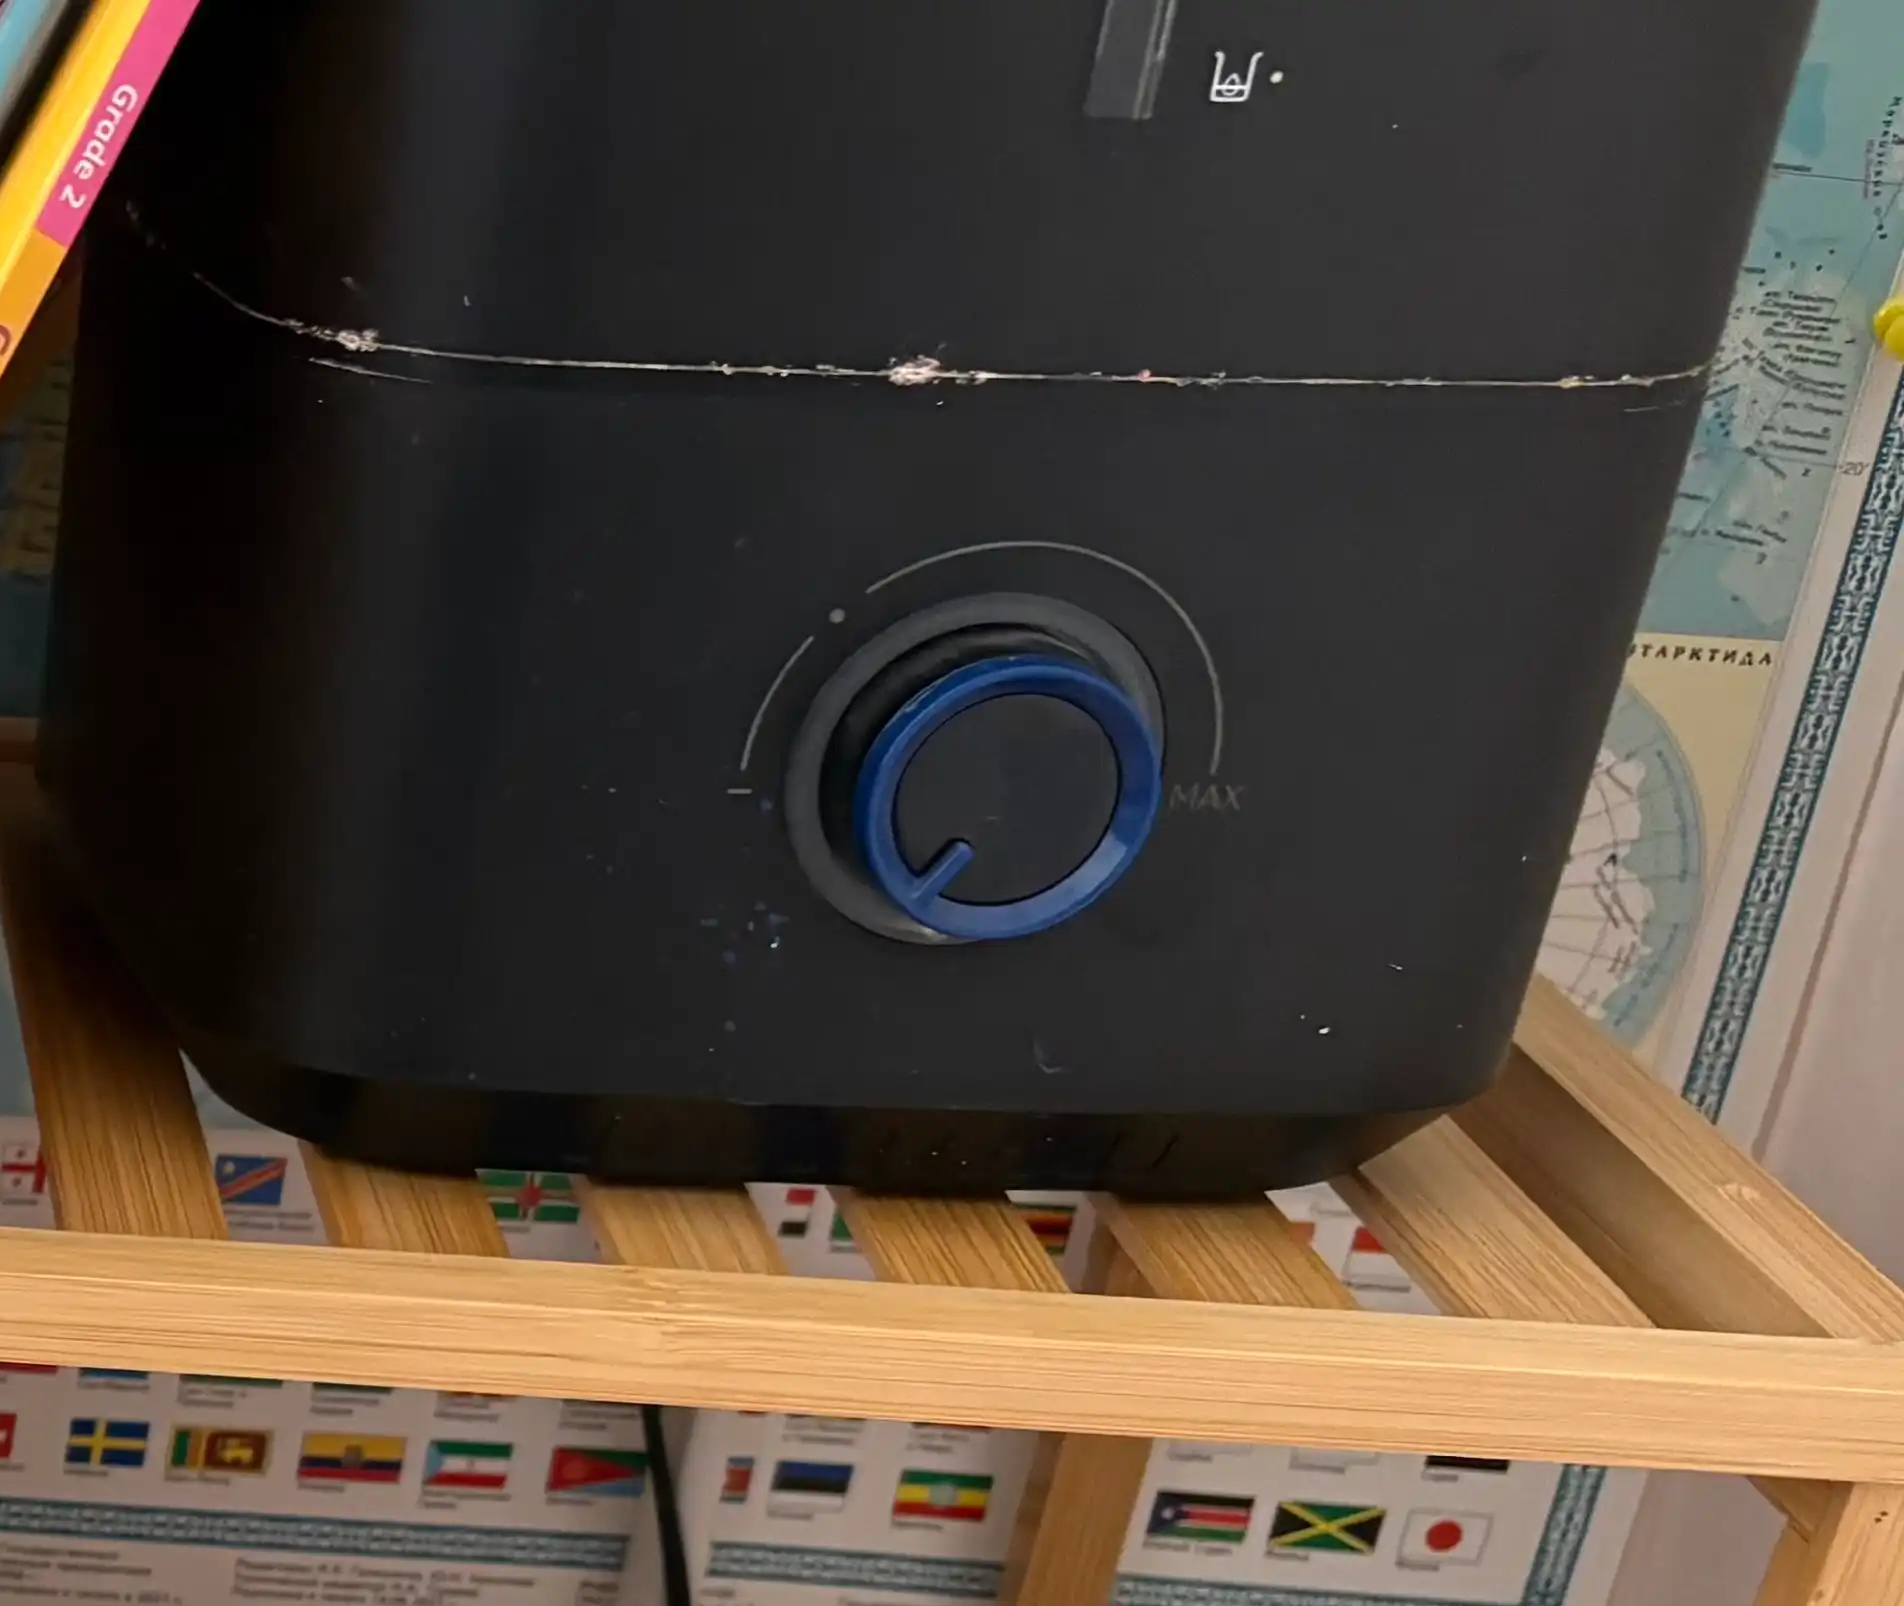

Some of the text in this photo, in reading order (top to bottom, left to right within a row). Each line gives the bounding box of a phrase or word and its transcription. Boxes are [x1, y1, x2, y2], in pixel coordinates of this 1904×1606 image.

[59, 84, 138, 210] Grade 2
[1169, 782, 1245, 812] MAX
